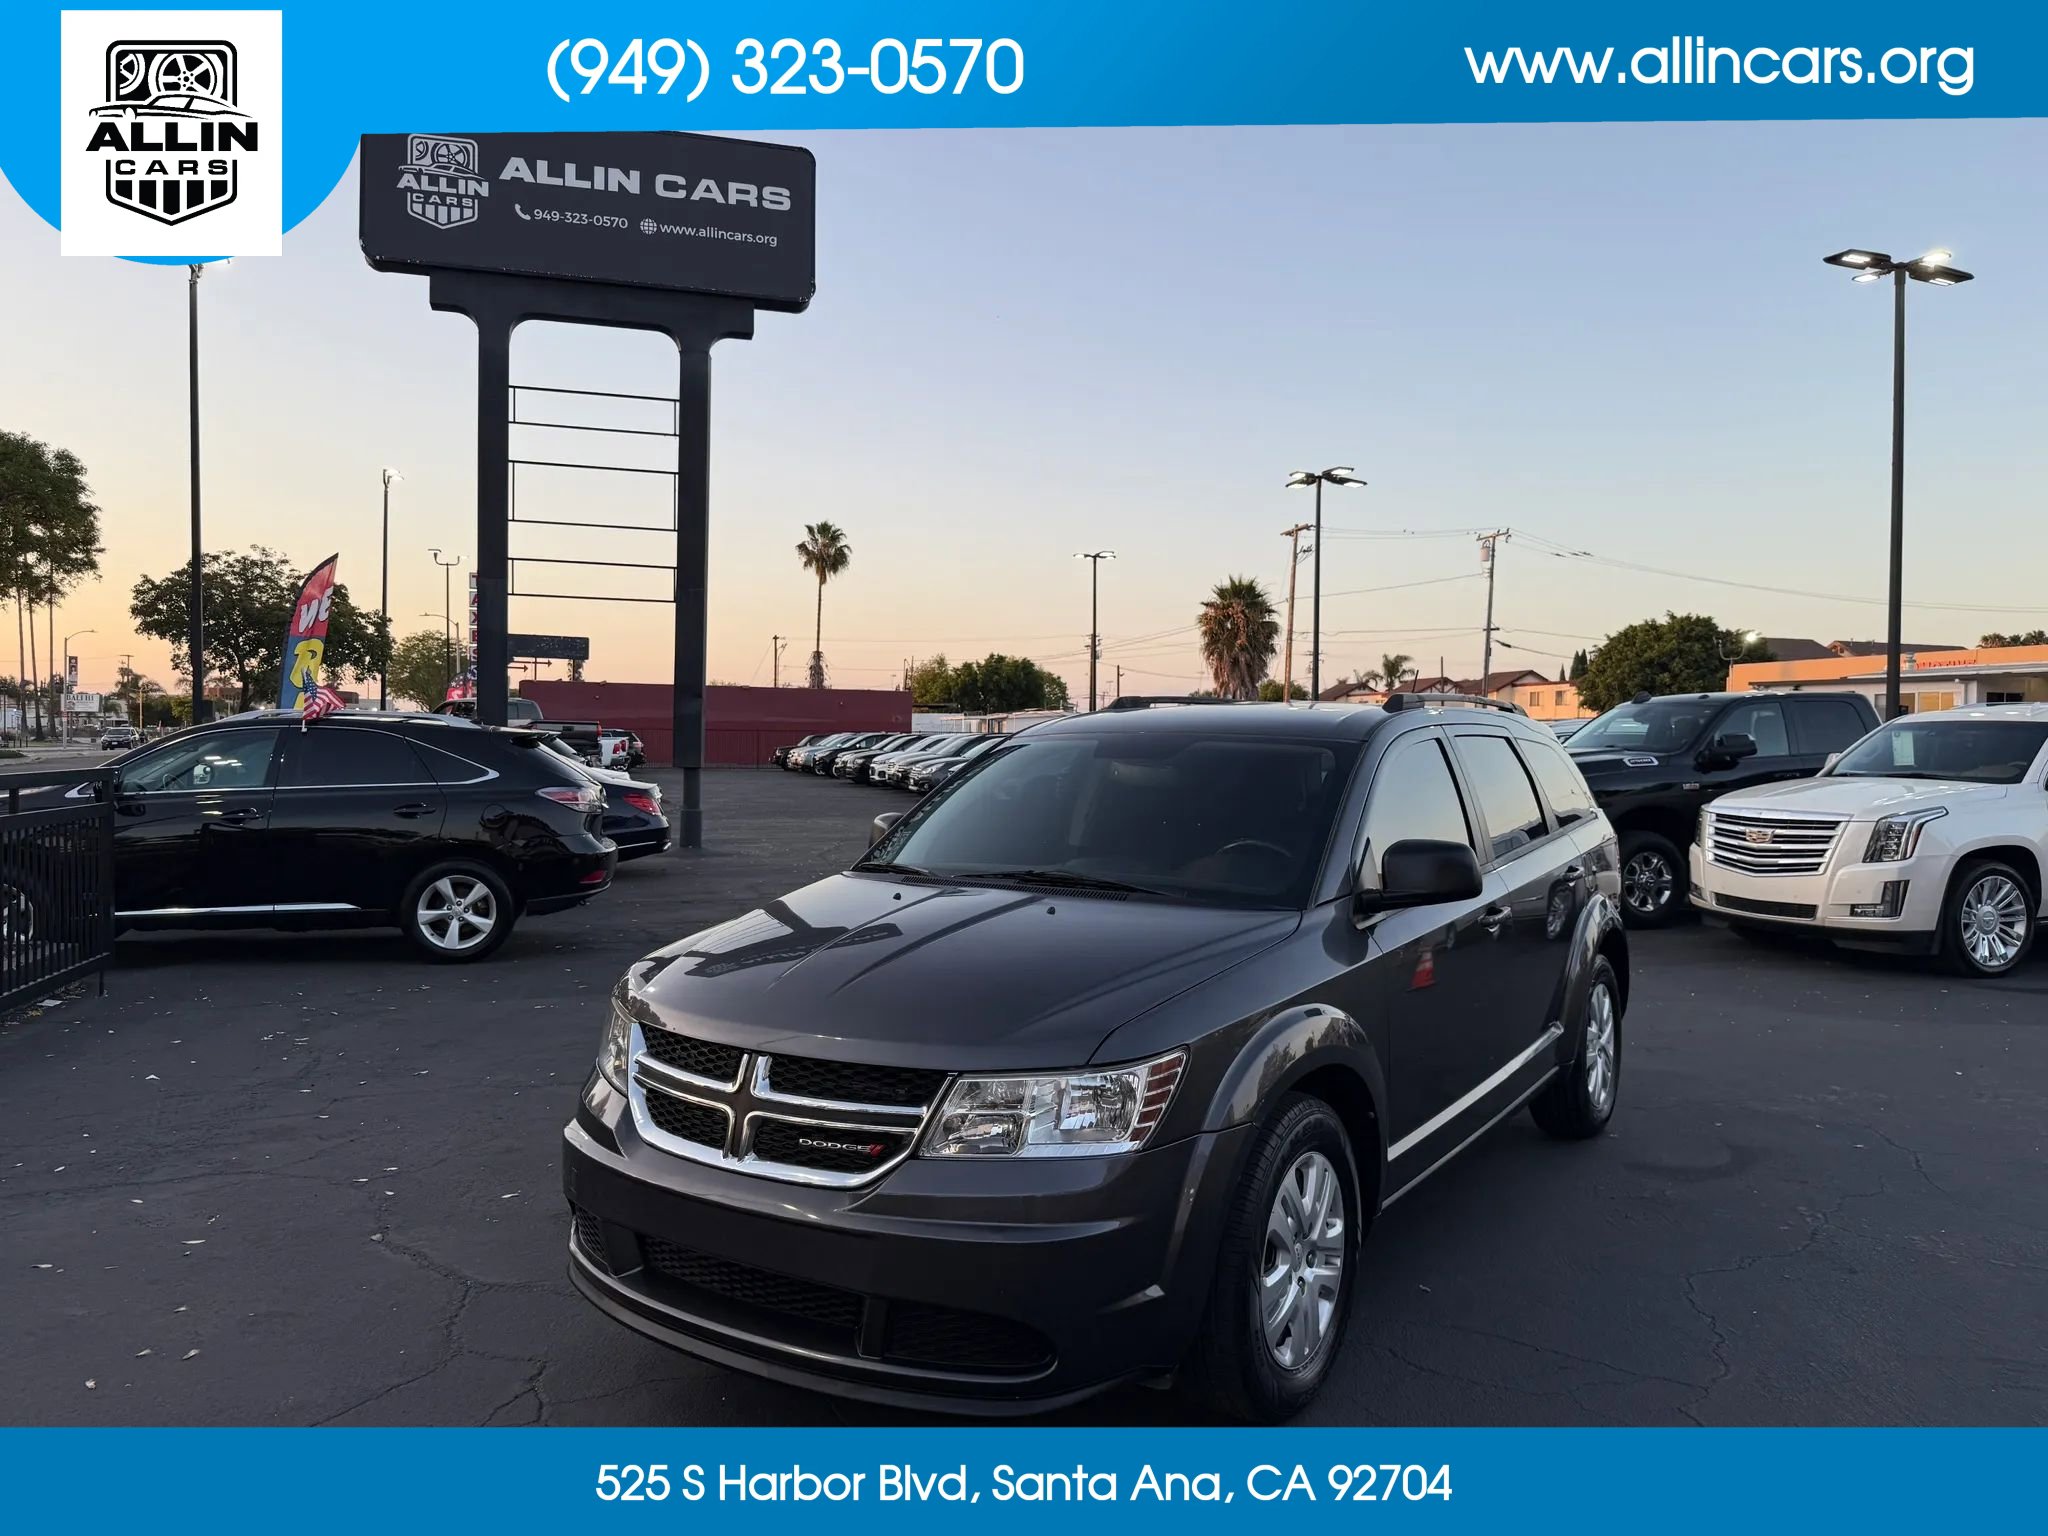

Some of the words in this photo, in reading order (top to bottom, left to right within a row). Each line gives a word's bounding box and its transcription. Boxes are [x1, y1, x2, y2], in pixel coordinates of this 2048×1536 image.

[397, 173, 489, 197] ALLIN
[499, 157, 640, 194] ALLIN
[655, 174, 791, 211] CARS
[412, 193, 473, 207] CARS
[533, 208, 629, 229] 949-323-0570
[659, 224, 778, 247] www.allincars.org
[799, 1138, 871, 1153] DODGE
